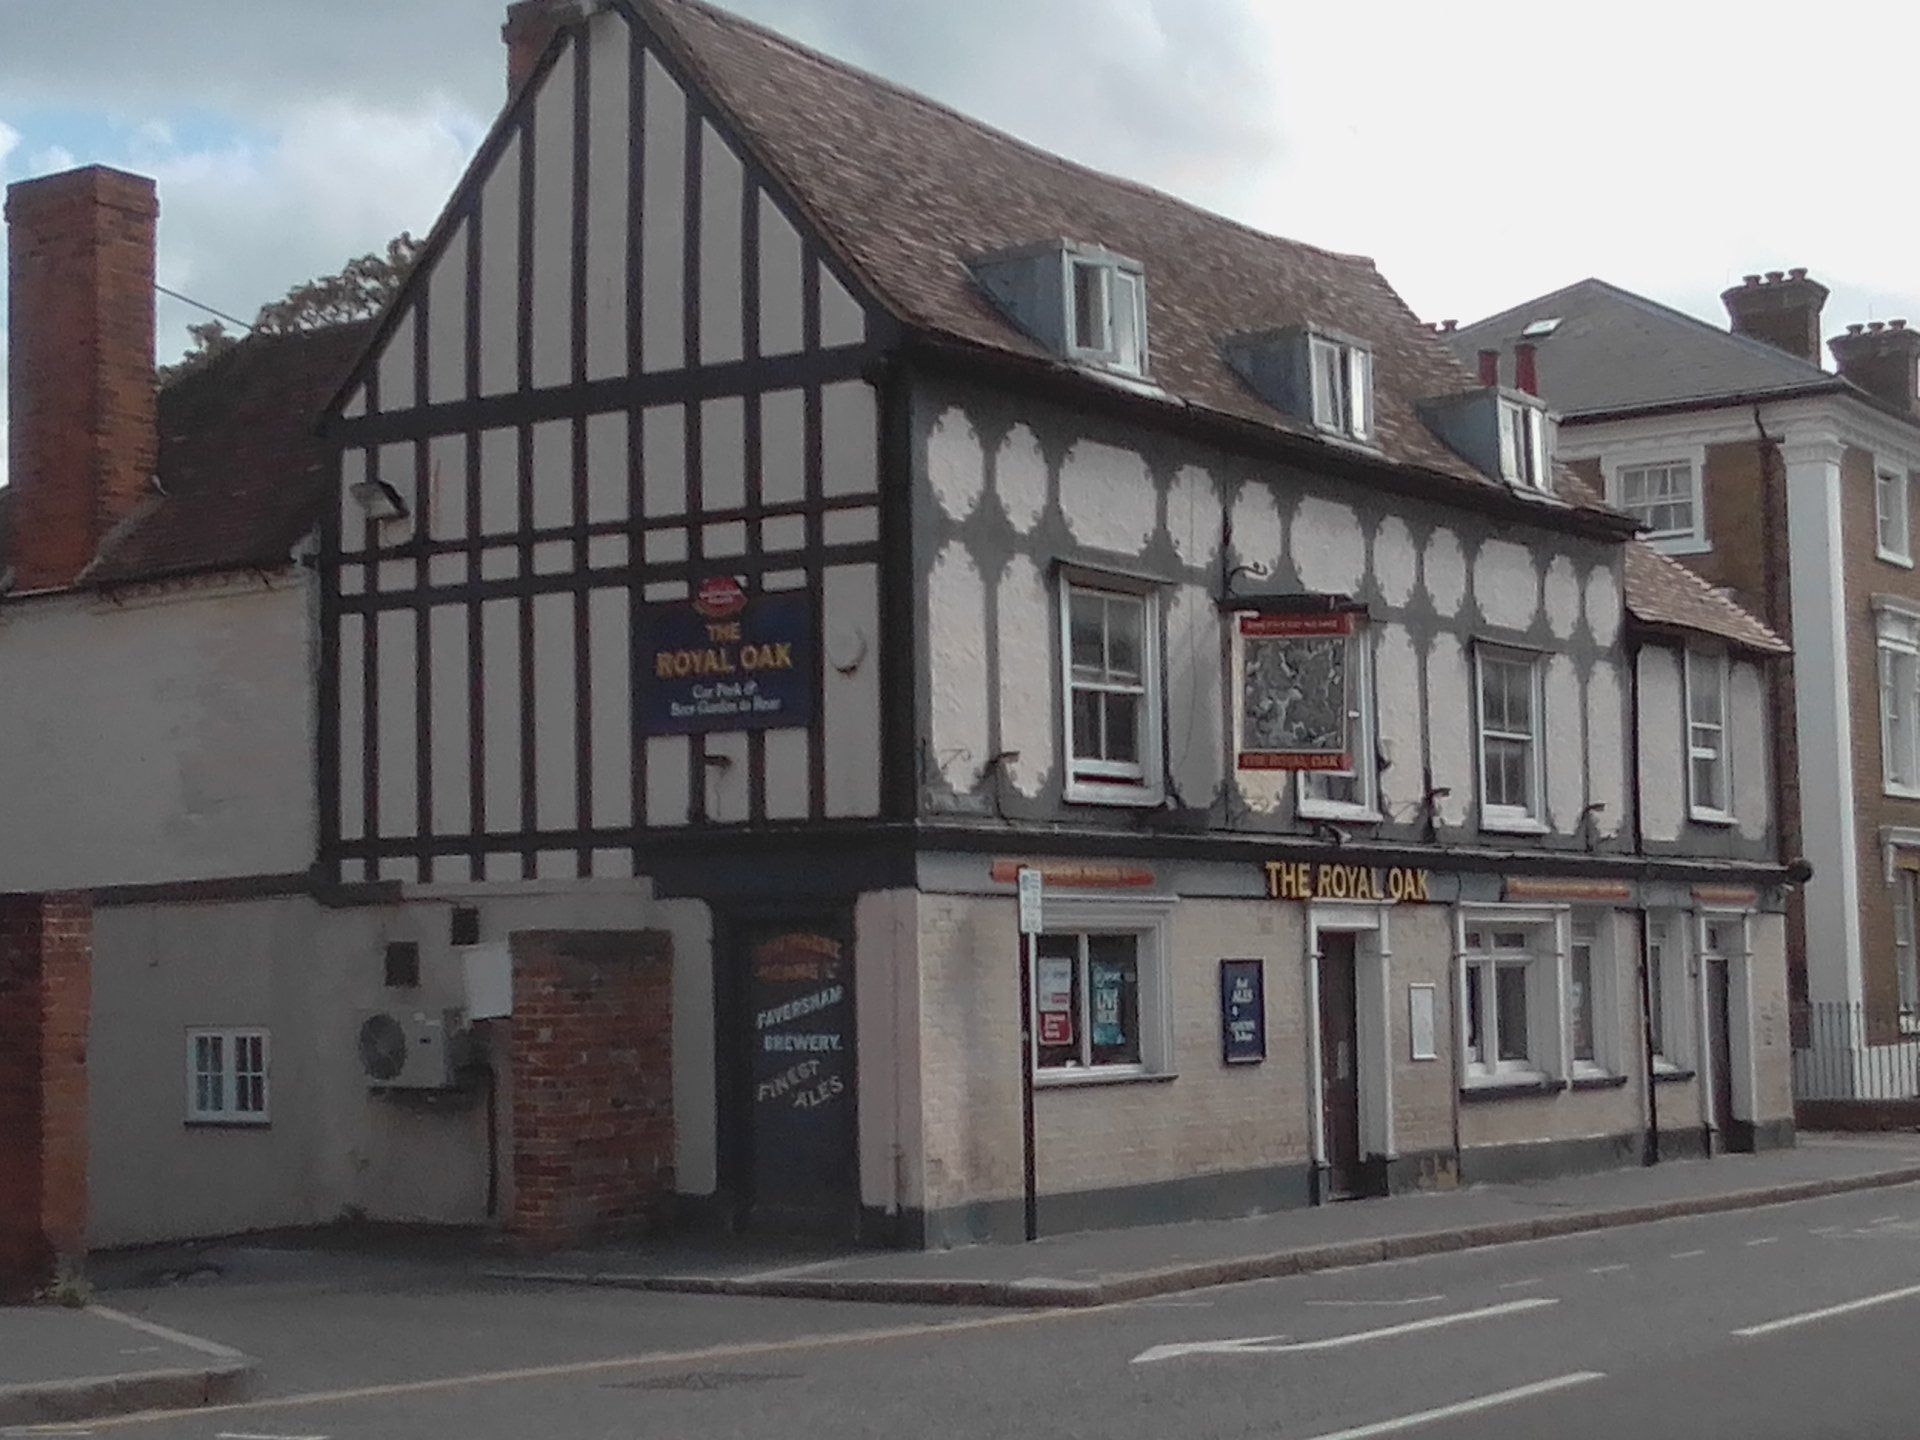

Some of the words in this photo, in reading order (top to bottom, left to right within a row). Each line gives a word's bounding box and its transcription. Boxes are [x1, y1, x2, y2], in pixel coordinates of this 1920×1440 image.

[706, 622, 741, 641] THE
[656, 648, 735, 678] ROYAL
[741, 643, 793, 669] OAK
[692, 684, 715, 698] Car
[716, 682, 742, 697] Park
[671, 702, 695, 717] Beer
[697, 699, 737, 715] Garden
[1265, 861, 1311, 898] THE
[1318, 863, 1384, 899] ROYAL
[1389, 867, 1430, 900] OAK
[757, 985, 843, 1028] FAVERSHAM
[757, 1060, 820, 1102] FINEST
[793, 1075, 844, 1108] ALES
